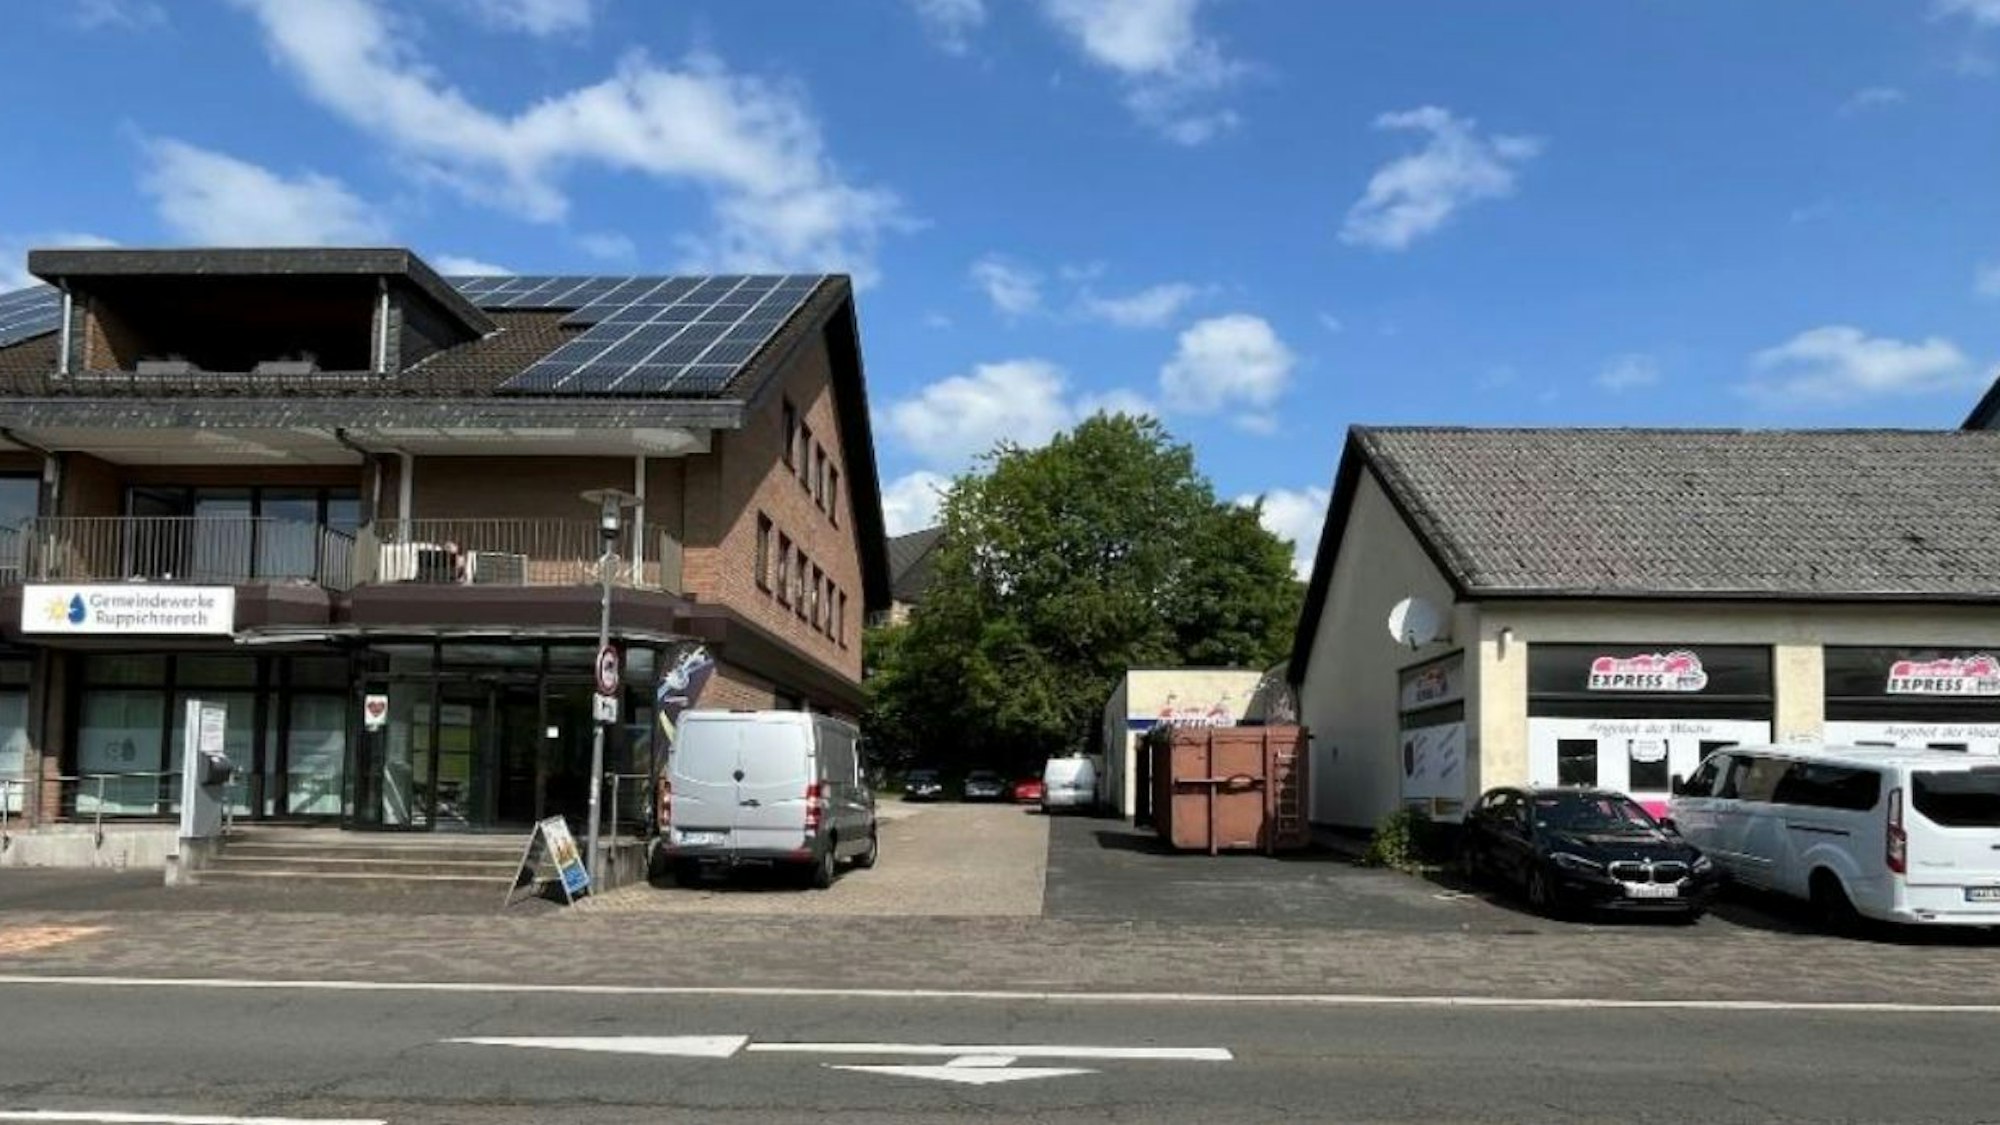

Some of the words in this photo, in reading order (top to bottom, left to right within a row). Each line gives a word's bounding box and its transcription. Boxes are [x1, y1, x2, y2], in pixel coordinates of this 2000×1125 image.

[90, 593, 214, 608] Gemeindewerke
[96, 610, 208, 626] Ruppichteroth
[1592, 674, 1664, 687] EXPRESS
[1891, 678, 1963, 691] EXPRESS
